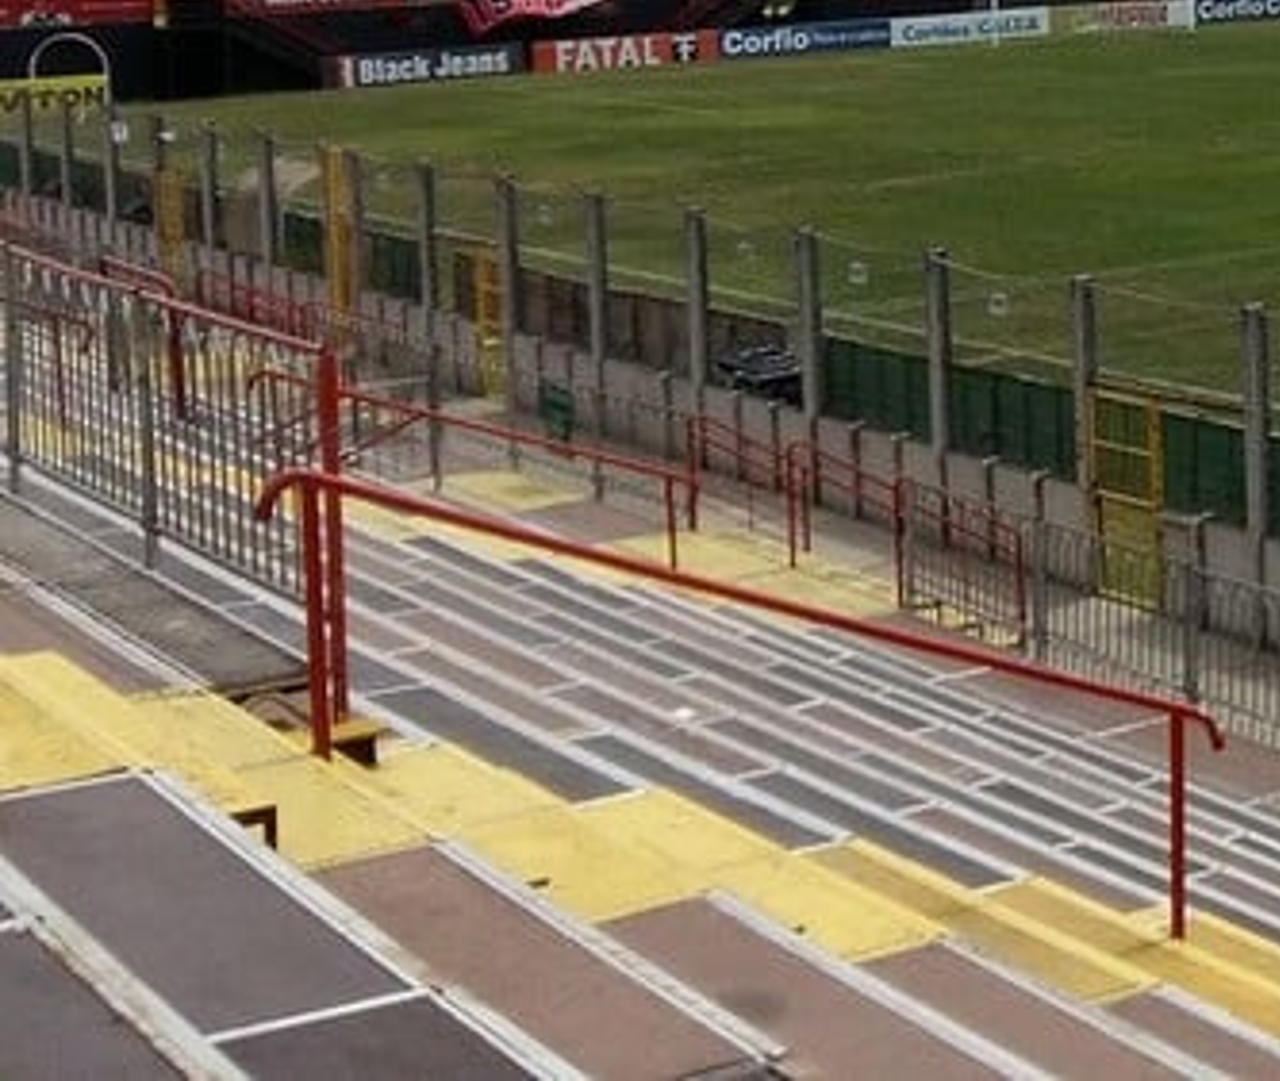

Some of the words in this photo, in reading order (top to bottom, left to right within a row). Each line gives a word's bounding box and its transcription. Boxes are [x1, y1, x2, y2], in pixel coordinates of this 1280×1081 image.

[360, 57, 430, 85] Black
[433, 51, 508, 77] Jeans
[555, 38, 661, 70] FATAL
